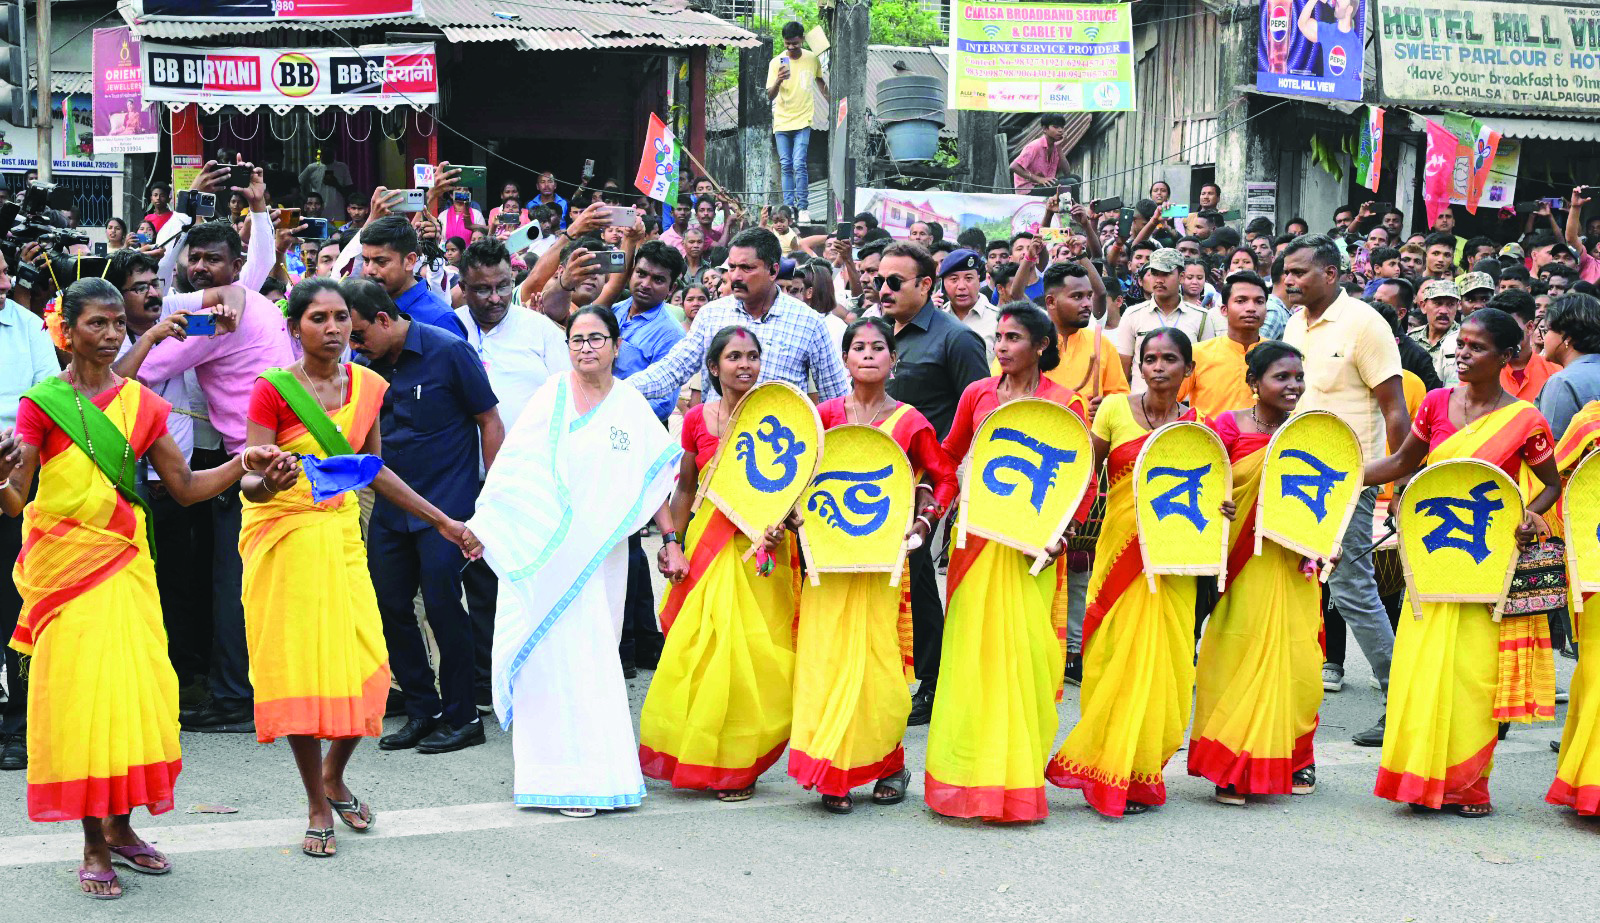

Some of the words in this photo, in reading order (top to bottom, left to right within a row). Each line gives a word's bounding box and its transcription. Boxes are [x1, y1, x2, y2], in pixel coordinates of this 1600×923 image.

[271, 1, 294, 11] 1980
[1006, 8, 1073, 21] BROADBAND
[1076, 9, 1118, 22] SERVICE
[1271, 20, 1288, 28] PEPSI
[1381, 6, 1484, 44] HOTEL
[1492, 12, 1561, 49] HILL
[1568, 17, 1600, 51] VI
[1012, 27, 1020, 38] &
[1023, 26, 1056, 38] CABLE
[1058, 26, 1073, 39] TV
[966, 43, 1018, 53] INTERNET
[1020, 44, 1066, 54] SERVICE
[1068, 44, 1120, 54] PROVIDER
[1395, 43, 1453, 61] SWEET
[1459, 47, 1547, 66] PARLOUR
[1330, 56, 1346, 66] PEPSI
[105, 69, 142, 80] ORIENT
[153, 57, 180, 83] BB
[183, 59, 257, 85] BIRYANI
[279, 62, 314, 87] BB
[337, 65, 362, 84] BB
[1278, 78, 1300, 89] HOTEL
[1301, 80, 1317, 91] HILL
[1317, 81, 1336, 92] VIEW
[1450, 71, 1485, 84] your
[1489, 71, 1553, 87] breakfast
[1556, 74, 1568, 87] to
[1433, 84, 1453, 96] P.O.
[53, 160, 70, 168] WEST
[983, 428, 1076, 512] ন
[1148, 464, 1210, 532] ব
[1416, 482, 1504, 564] র্ষ
